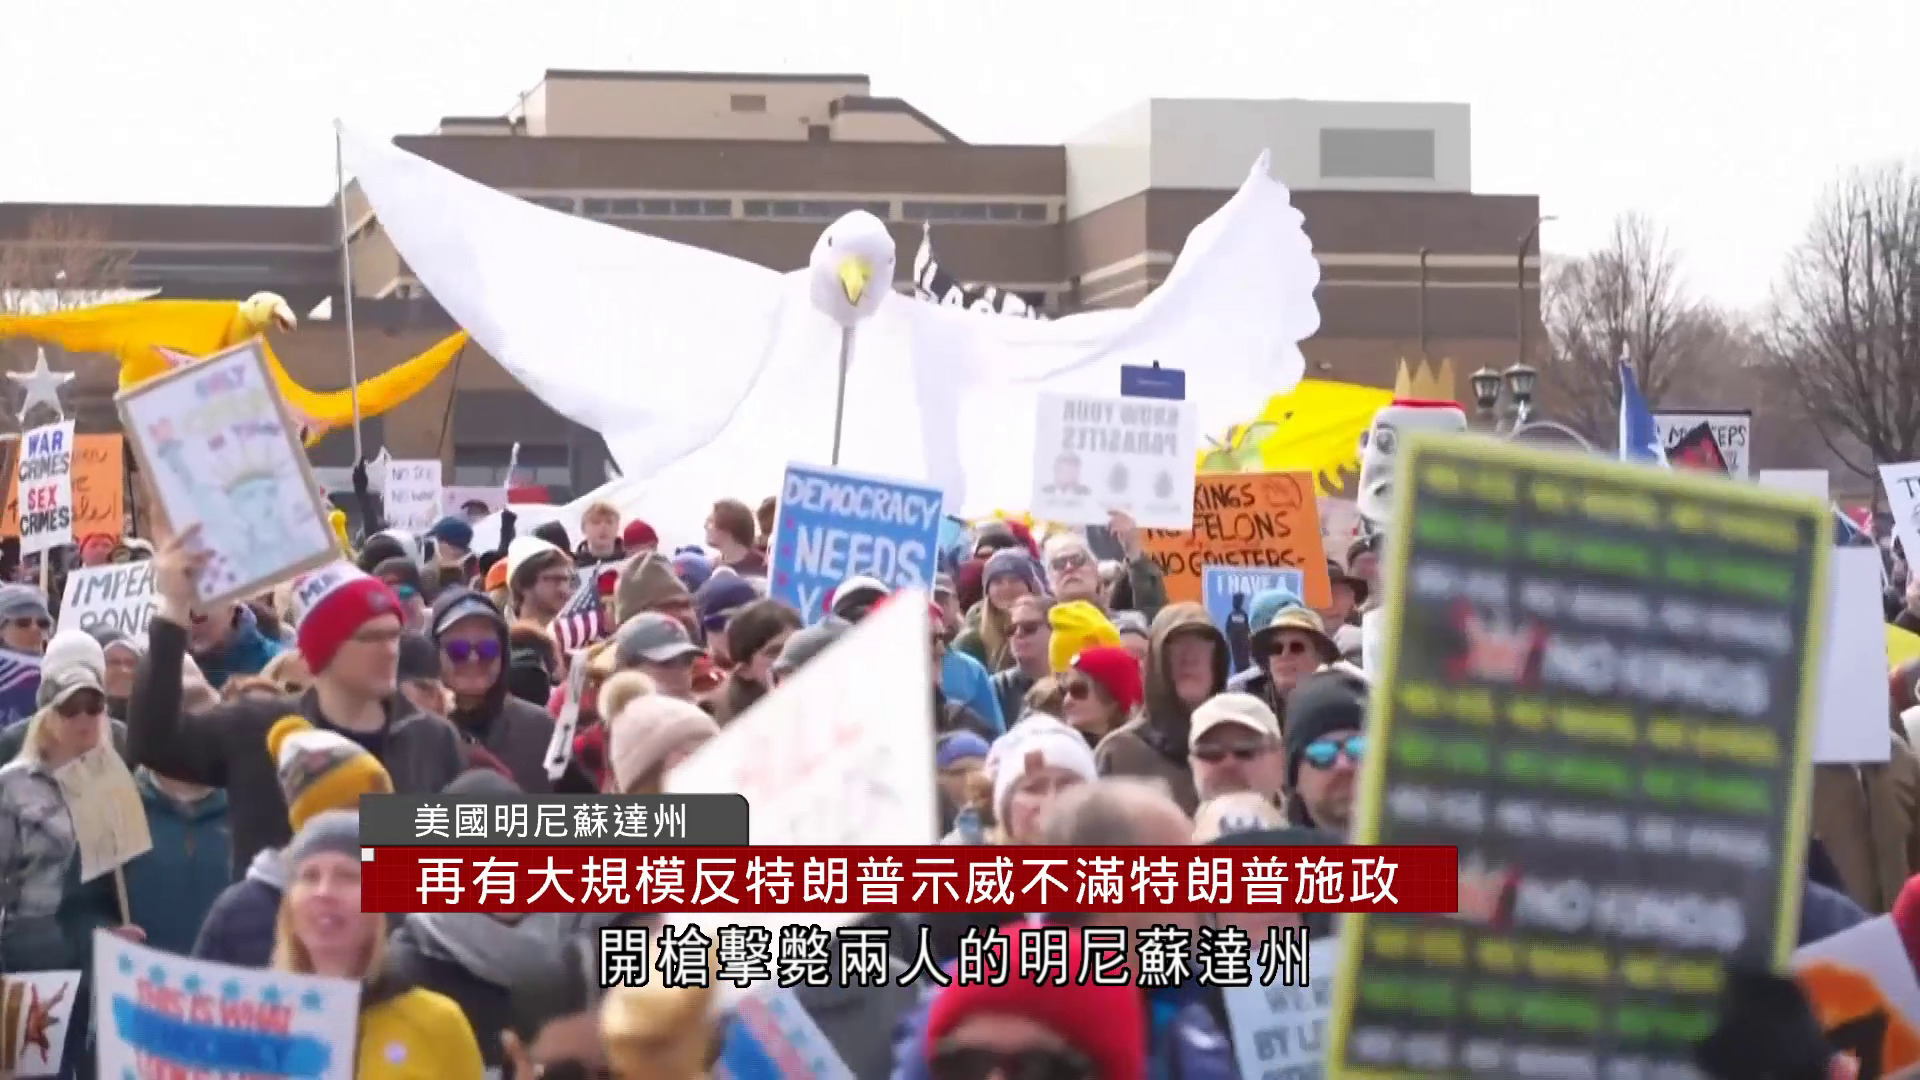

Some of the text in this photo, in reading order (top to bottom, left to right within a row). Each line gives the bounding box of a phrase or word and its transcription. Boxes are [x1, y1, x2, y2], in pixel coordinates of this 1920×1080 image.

[28, 430, 63, 457] WAR
[19, 451, 70, 482] CRIMES
[27, 484, 58, 512] SEX
[782, 473, 941, 531] DEMOCRACY
[20, 505, 70, 537] CRIMES
[1193, 510, 1292, 543] FELONS
[794, 523, 927, 588] NEEDS
[1152, 551, 1185, 577] NO
